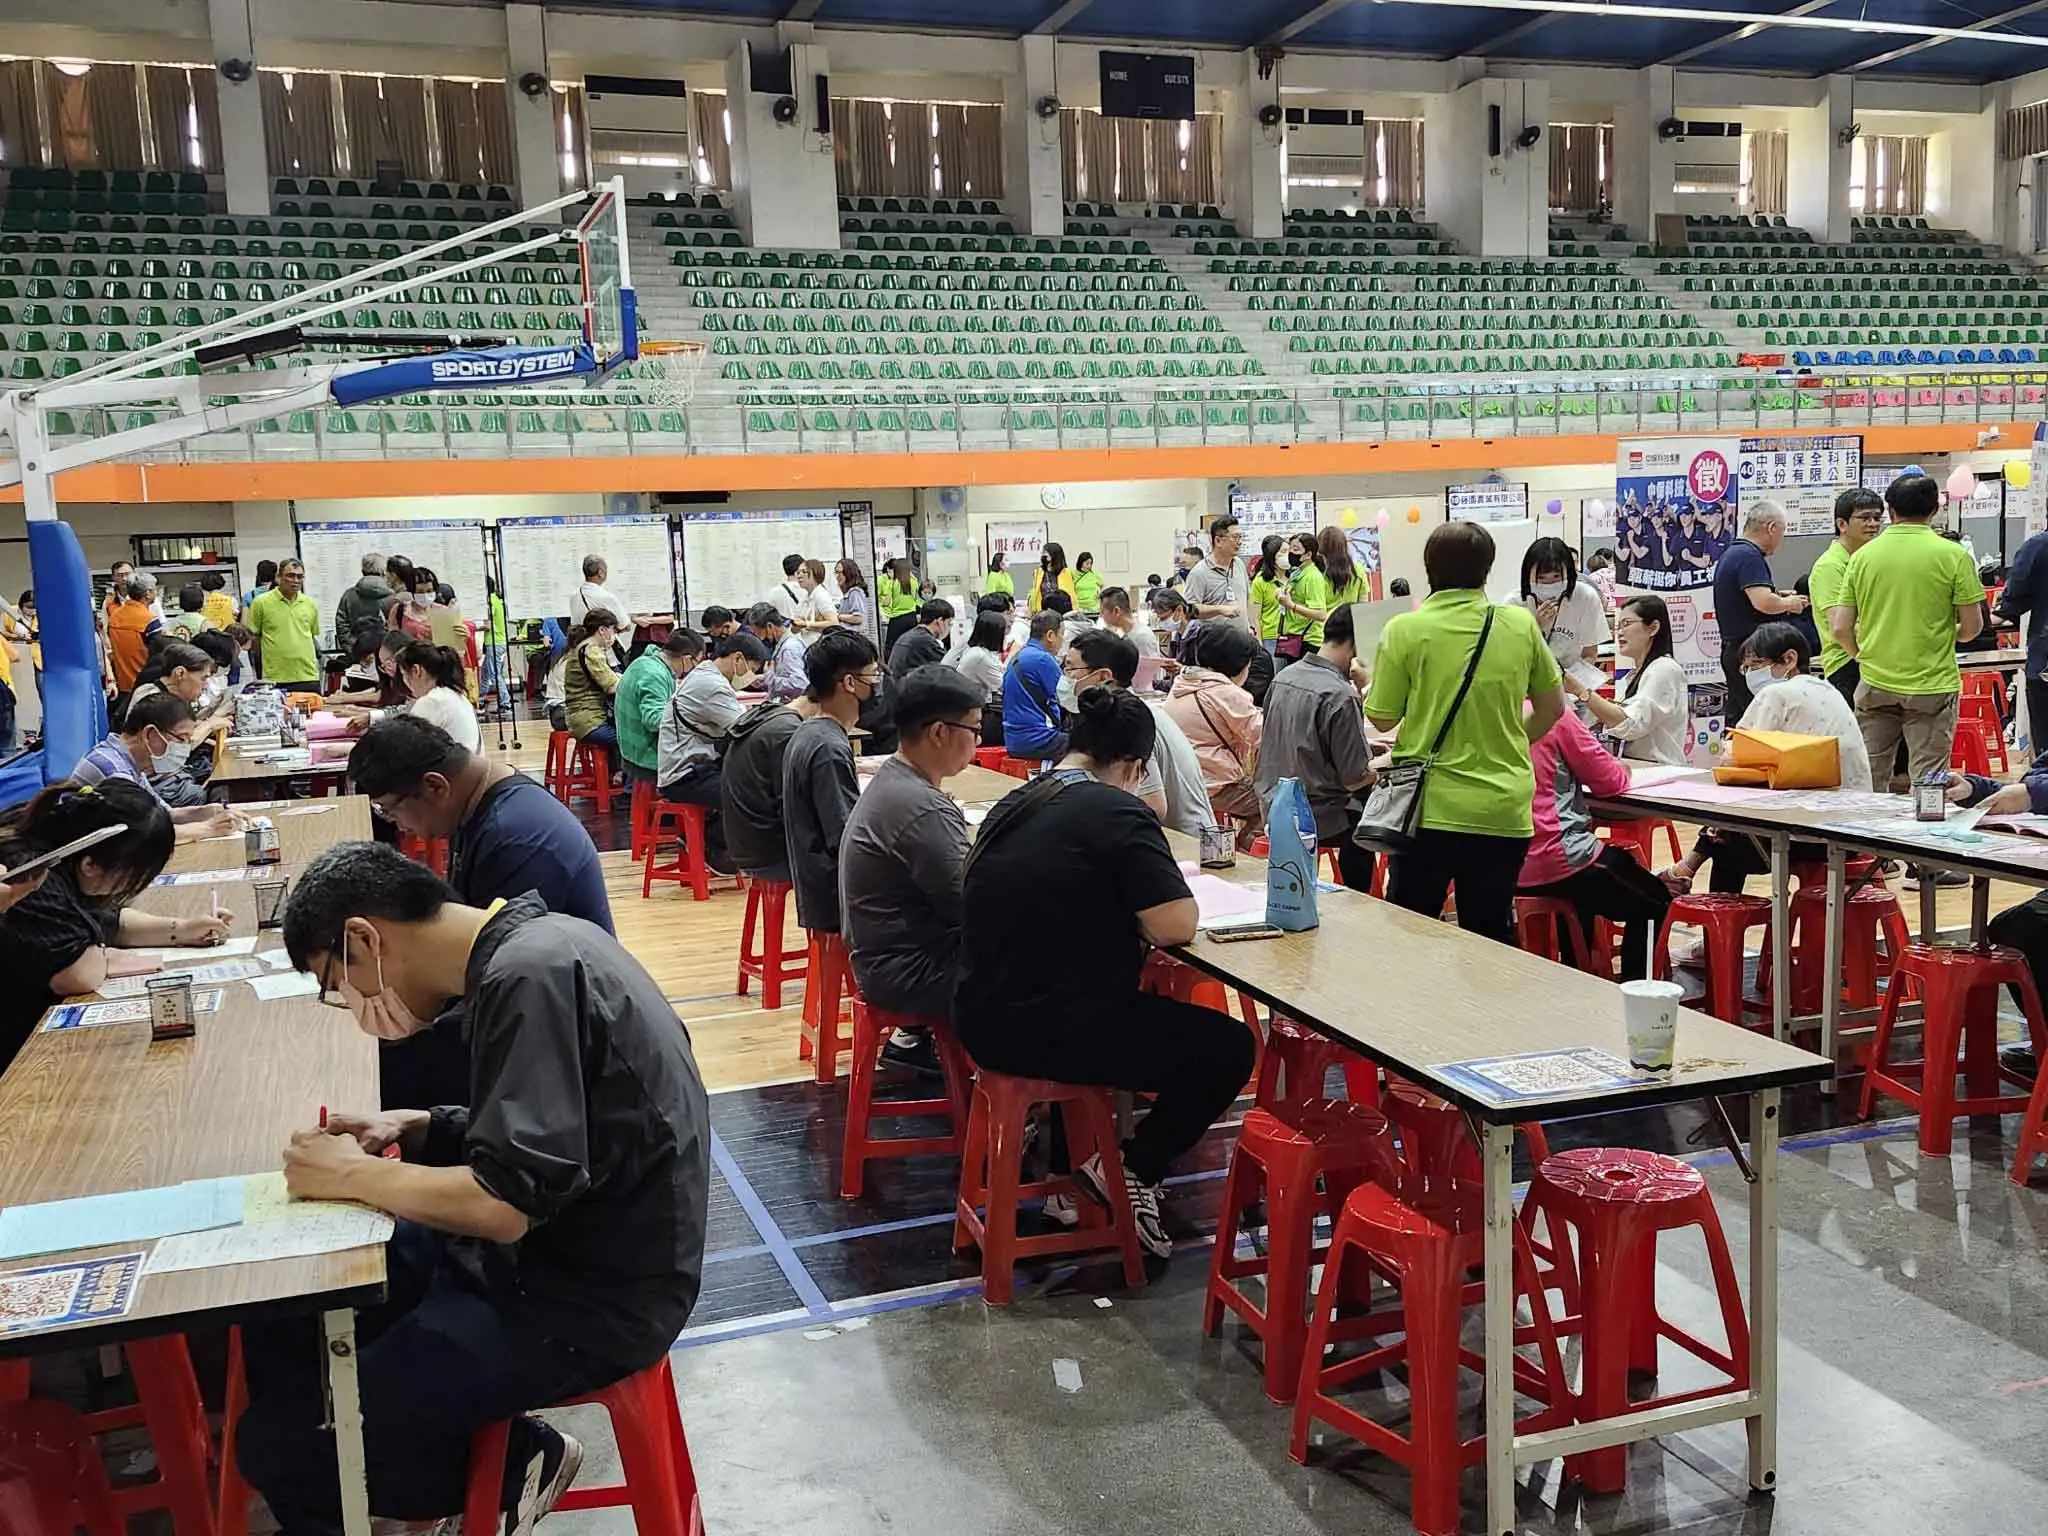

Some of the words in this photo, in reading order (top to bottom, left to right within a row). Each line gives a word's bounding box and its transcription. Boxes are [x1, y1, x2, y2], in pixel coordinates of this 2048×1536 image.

[1109, 71, 1128, 81] HOME
[1164, 74, 1189, 85] GUESTS
[1756, 451, 1858, 468] 中興保全科技
[1756, 466, 1858, 485] 股份有限公司
